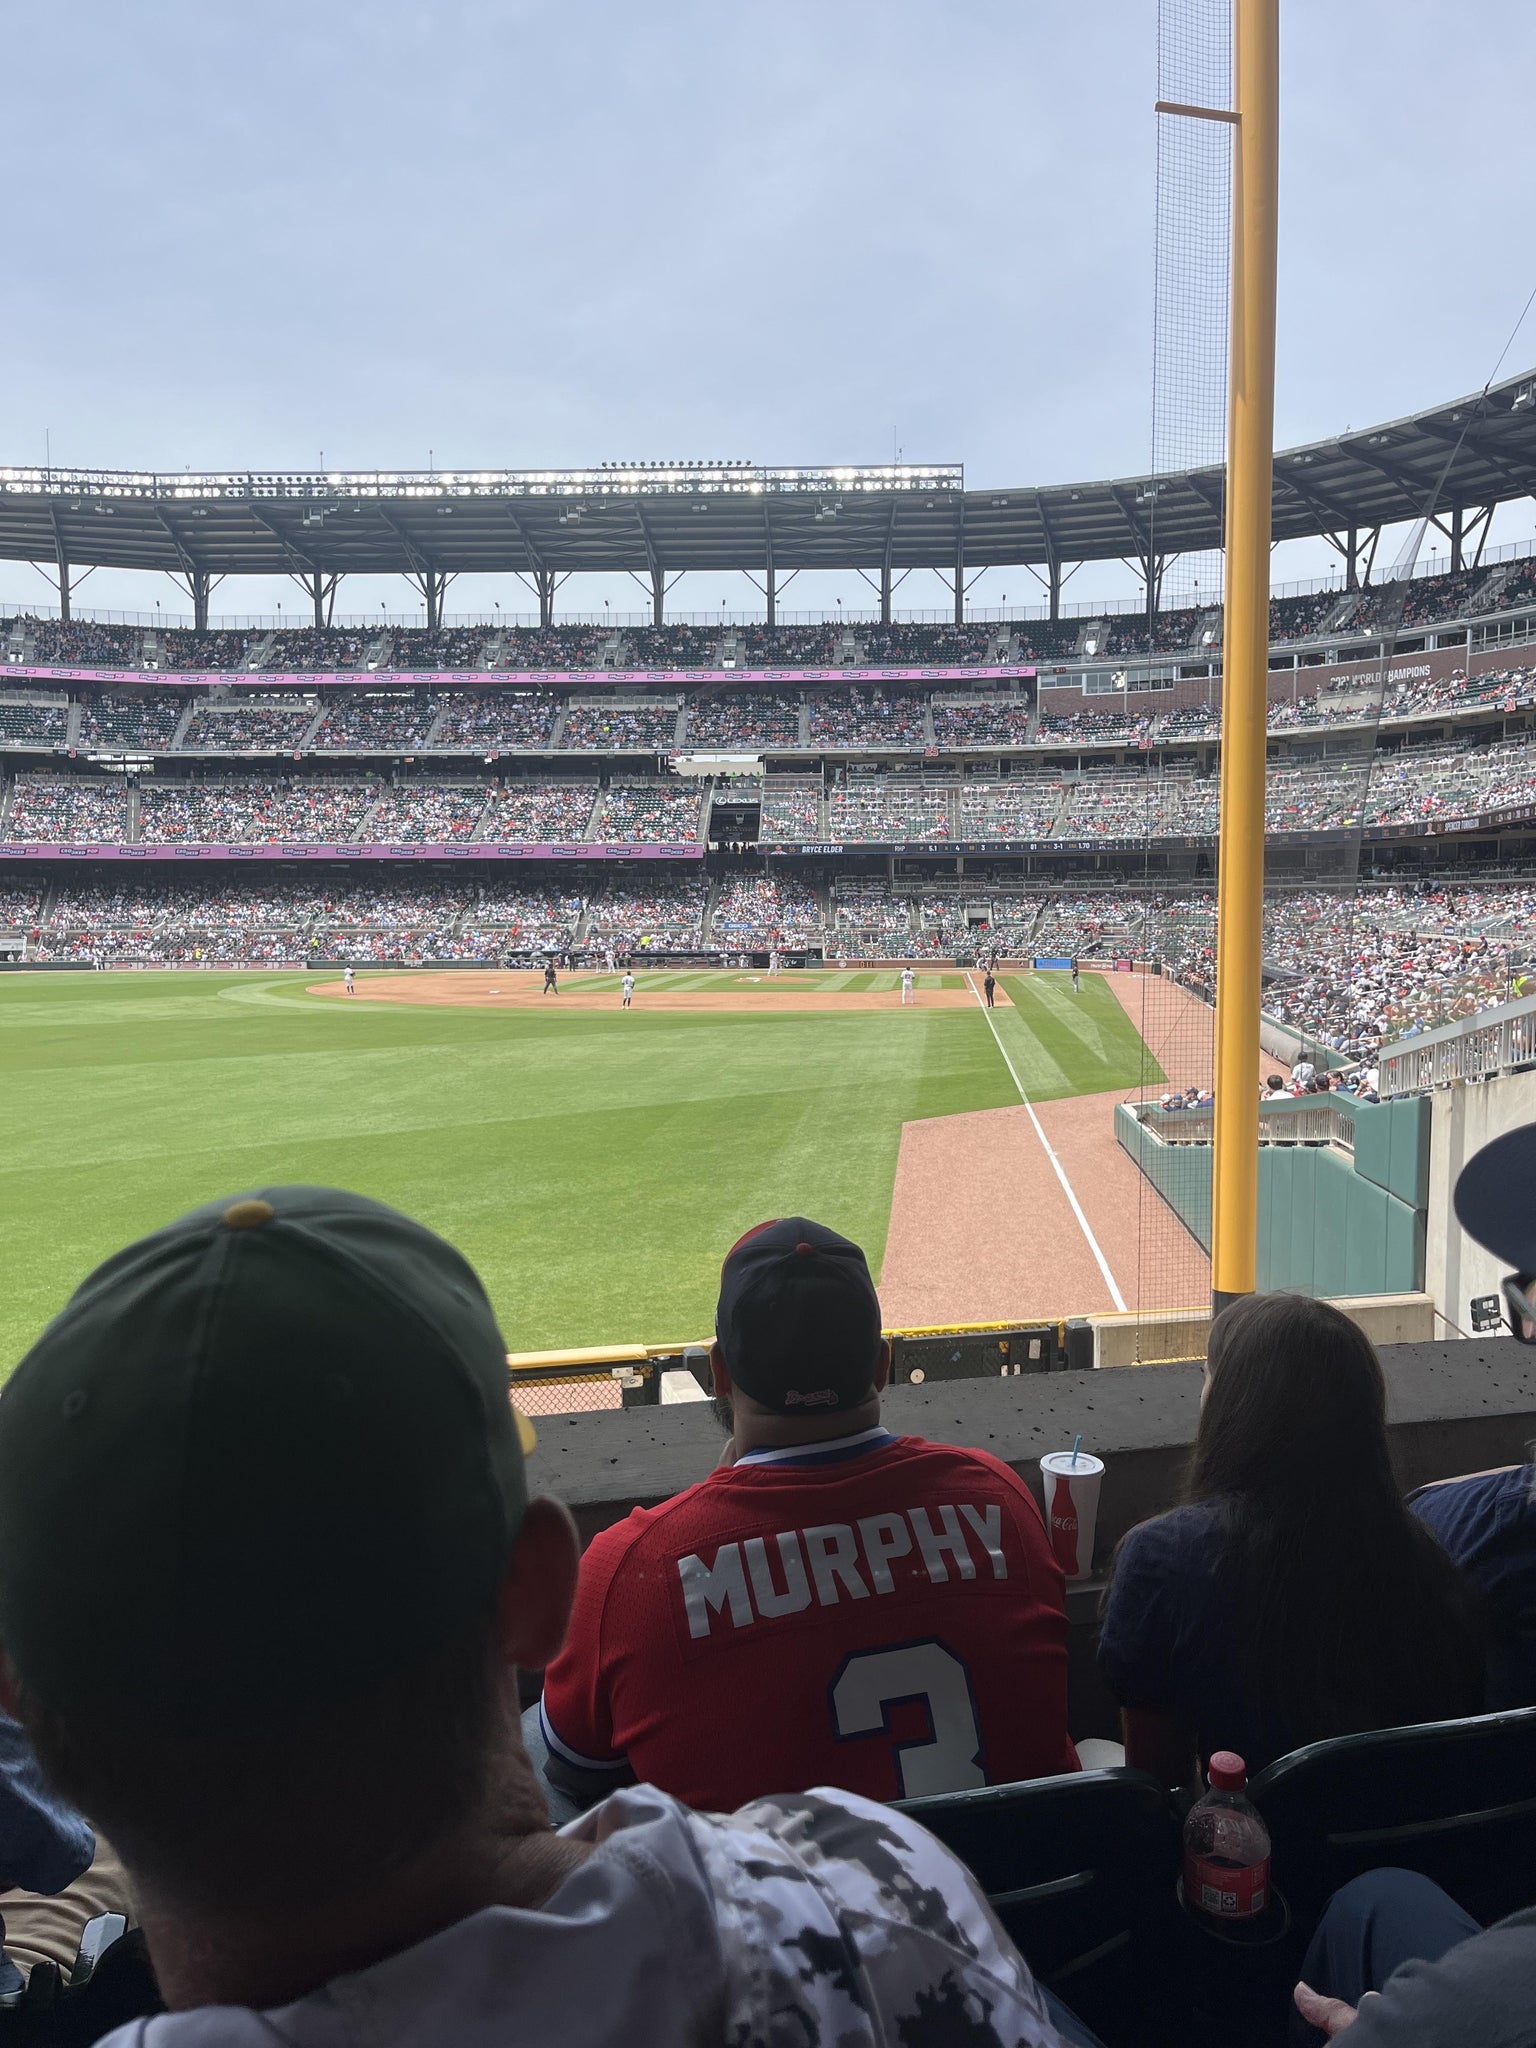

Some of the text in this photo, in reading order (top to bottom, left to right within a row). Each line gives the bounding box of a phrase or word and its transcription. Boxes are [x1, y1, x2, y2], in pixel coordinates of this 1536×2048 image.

[1352, 672, 1381, 684] WORLD
[1383, 665, 1431, 682] CHAMPIONS
[801, 845, 822, 853] BRYCE
[823, 845, 843, 853] ELDER
[678, 1504, 1008, 1639] MURPHY
[828, 1636, 989, 1799] 3
